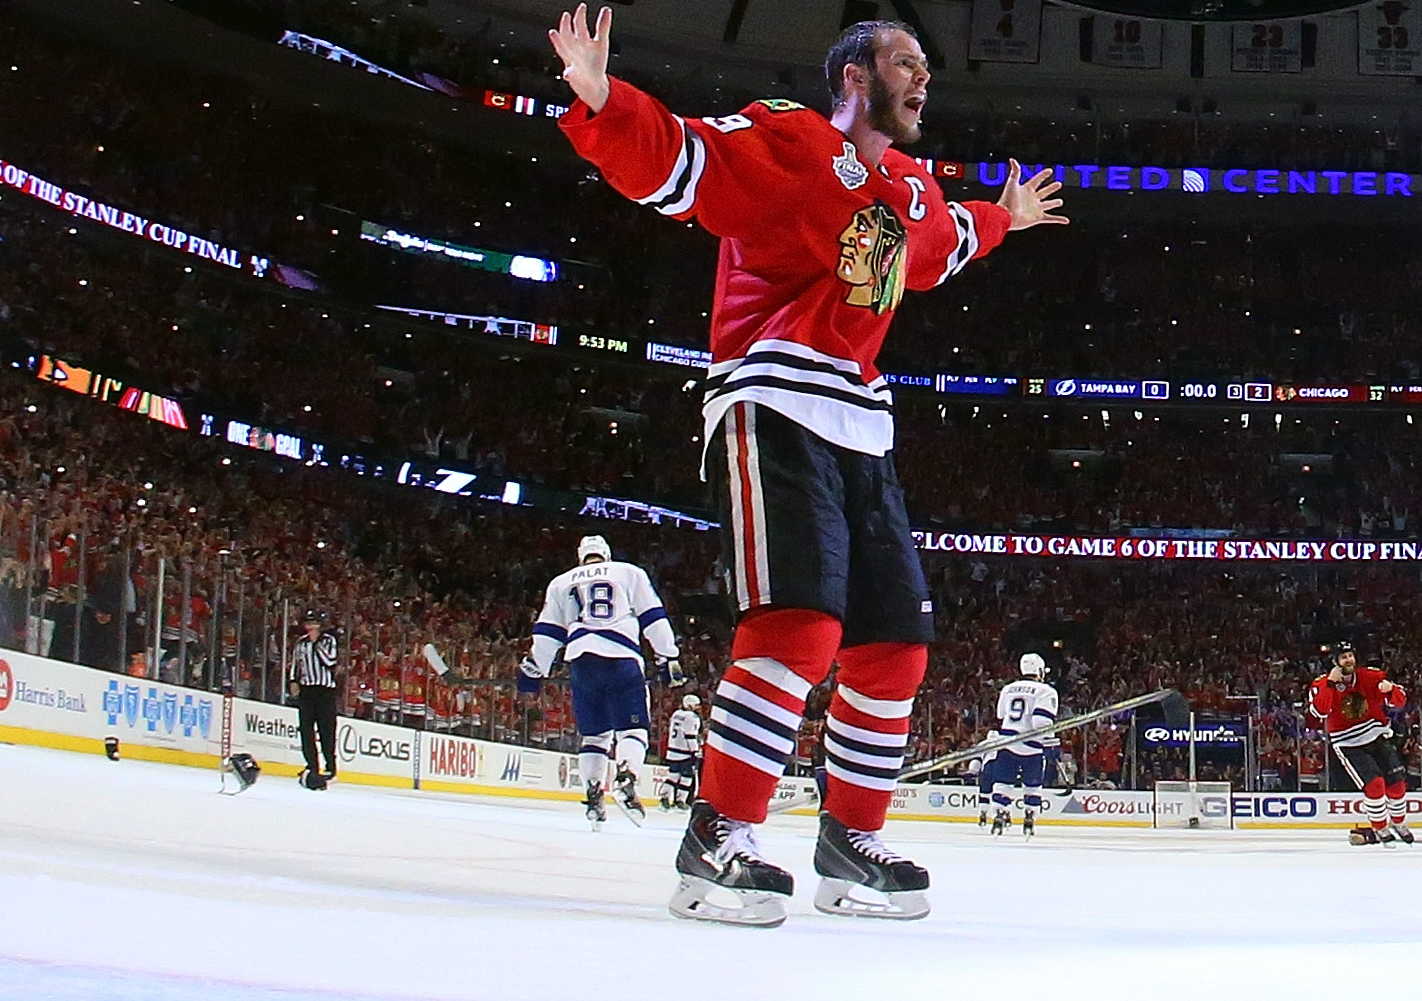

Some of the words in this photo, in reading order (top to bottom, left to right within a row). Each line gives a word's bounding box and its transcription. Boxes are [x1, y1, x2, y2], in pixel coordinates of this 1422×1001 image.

[1222, 168, 1413, 196] CENTER
[904, 176, 927, 221] C
[4, 164, 28, 188] OF
[28, 175, 63, 206] THE
[63, 191, 148, 236] STANLEY
[149, 223, 187, 248] CUP
[187, 235, 242, 269] FINAL
[578, 334, 605, 349] 9:53
[607, 339, 628, 353] PM
[900, 375, 931, 387] CLUB
[1080, 383, 1115, 394] TAMPA
[1150, 384, 1159, 395] 0
[1180, 384, 1217, 397] :00.0
[1253, 386, 1263, 397] 2
[1299, 387, 1349, 398] CHICAGO
[227, 420, 251, 446] ONE
[911, 530, 1007, 553] ELCOME
[1012, 536, 1043, 554] TO
[1048, 537, 1116, 556] GAME
[1121, 539, 1132, 557] 6
[1137, 539, 1169, 558] OF
[1174, 540, 1219, 559] THE
[1223, 540, 1326, 560] STANLEY
[1330, 541, 1376, 560] CUP
[571, 567, 610, 582] PALAT
[567, 580, 614, 623] 18
[15, 681, 56, 708] Harris
[57, 695, 88, 713] Bank
[1008, 697, 1026, 722] 9
[245, 713, 299, 738] Weather
[358, 735, 410, 761] LEXUS
[429, 736, 477, 778] HARIBO
[780, 791, 795, 800] APP
[1081, 795, 1135, 815] Coors
[1137, 801, 1184, 816] LIGHT
[1201, 797, 1317, 818] GEICO
